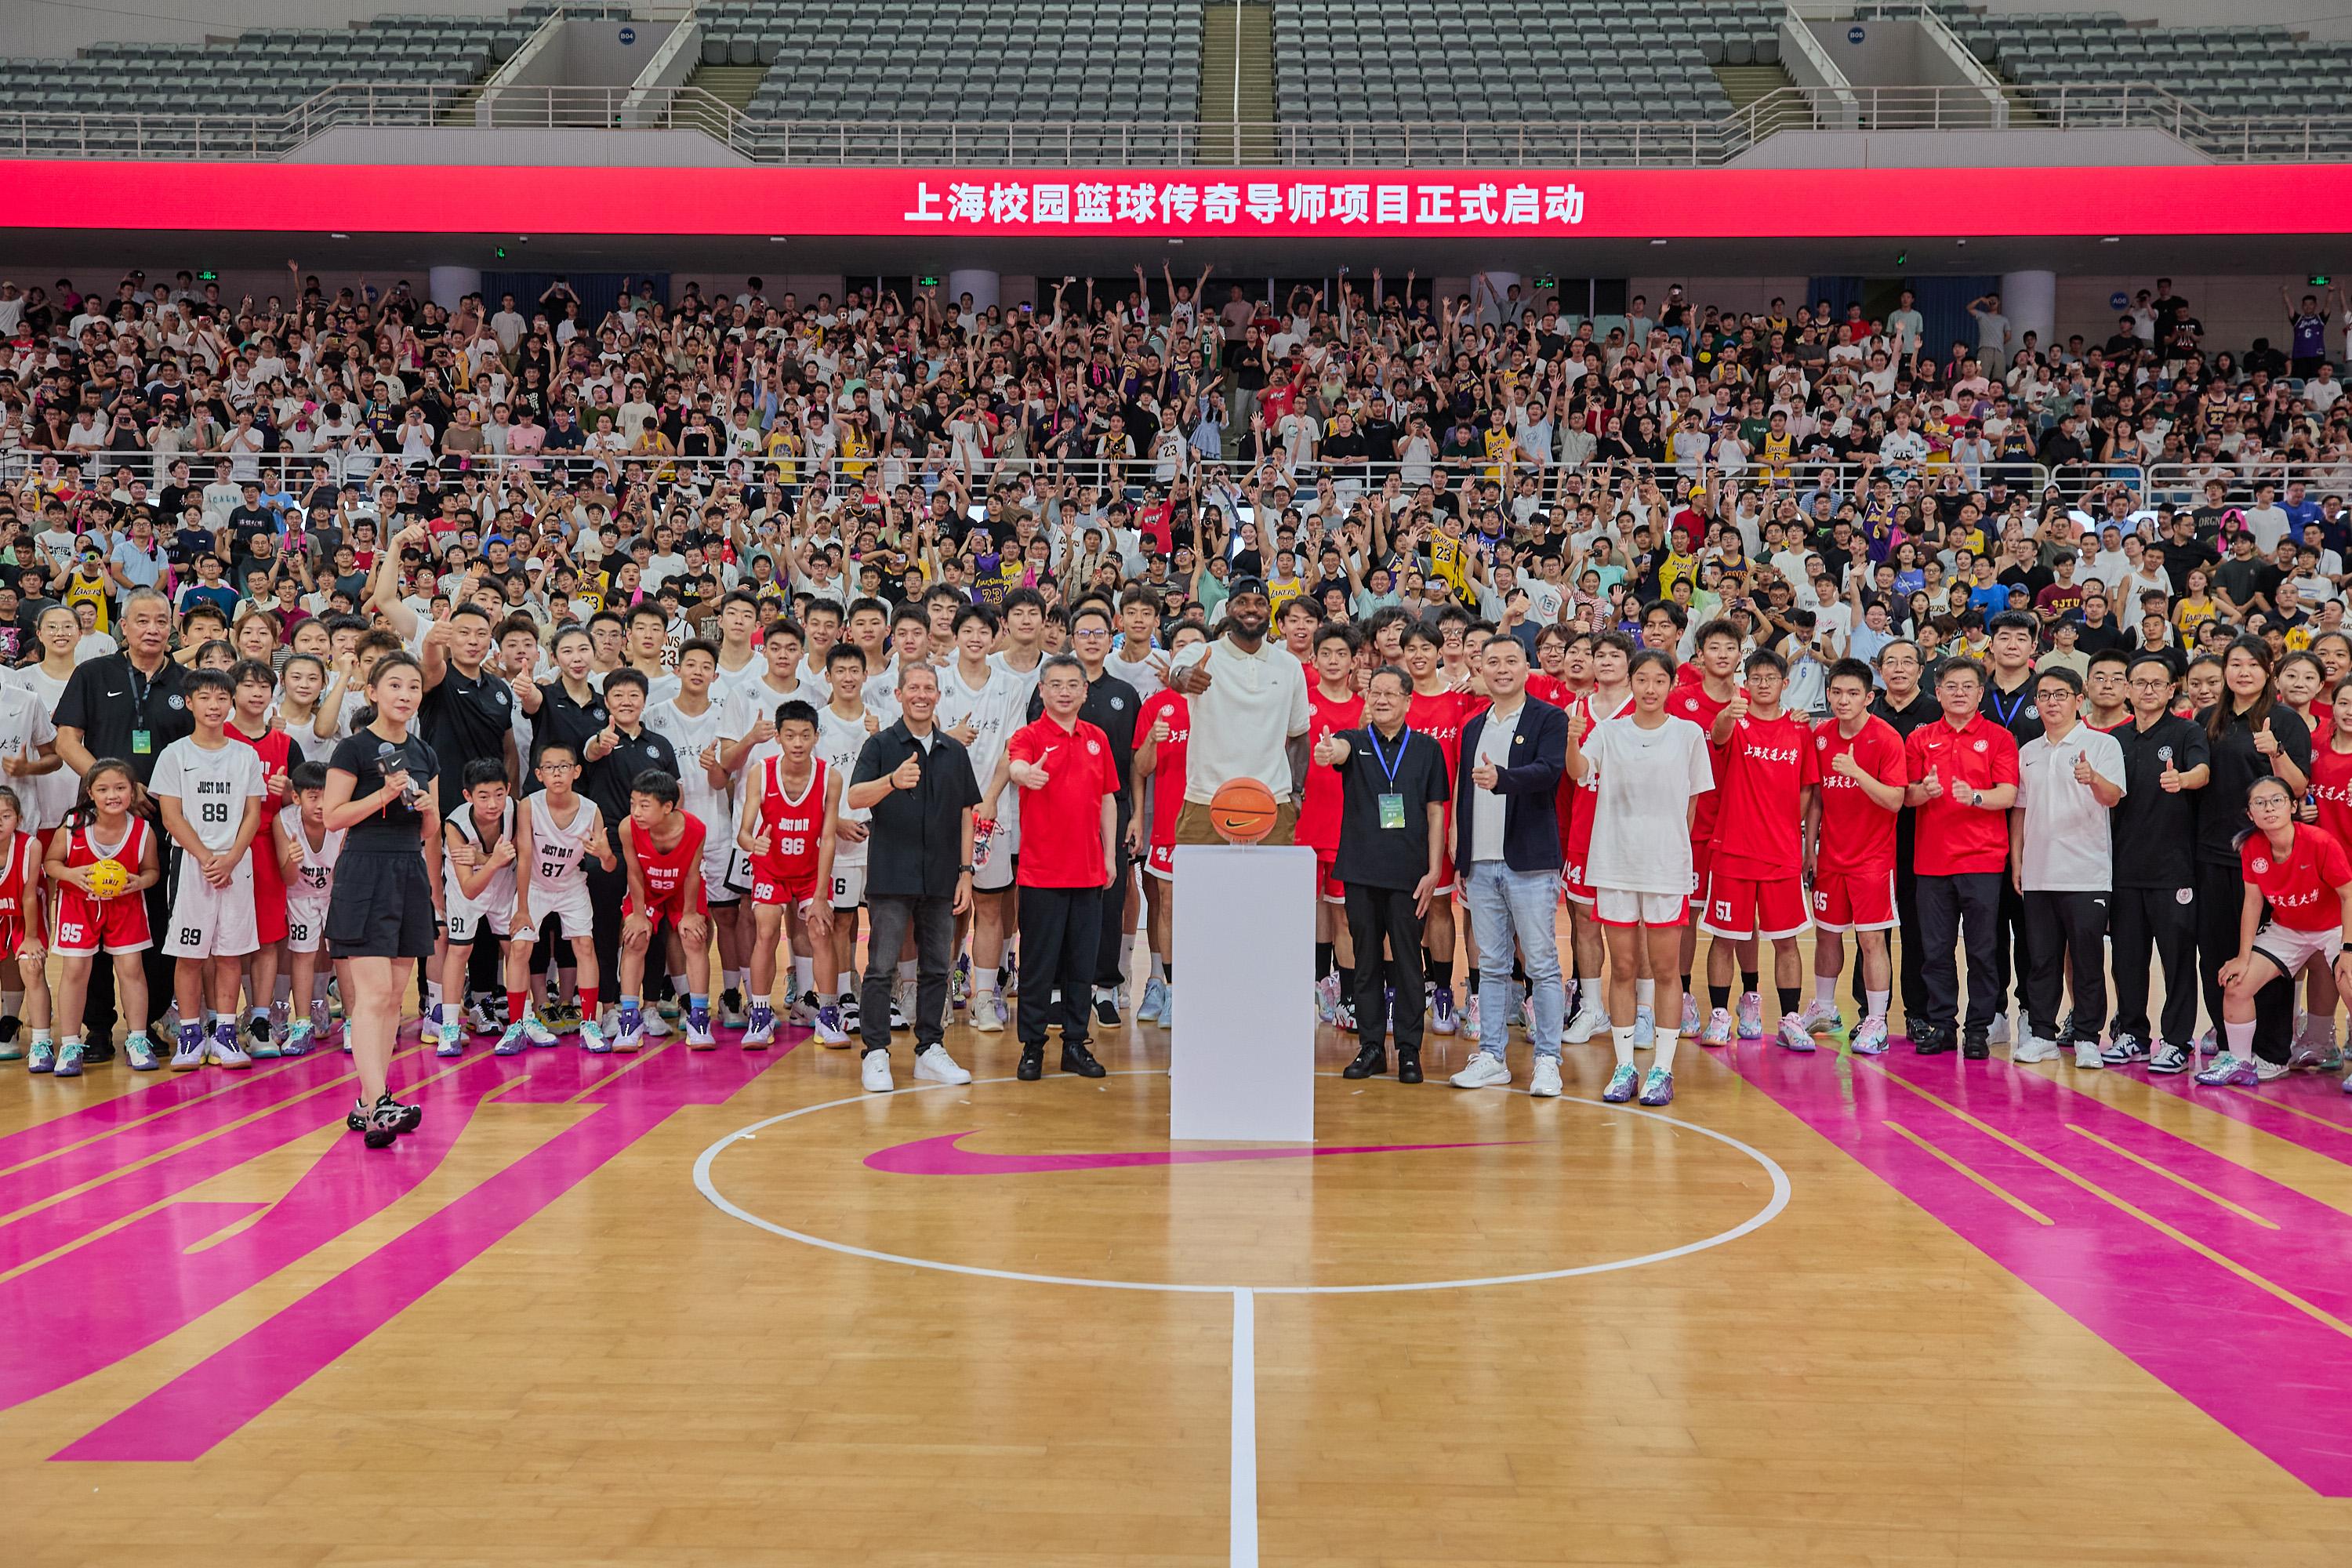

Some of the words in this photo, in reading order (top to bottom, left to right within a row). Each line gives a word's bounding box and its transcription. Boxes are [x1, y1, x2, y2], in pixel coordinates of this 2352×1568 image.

[904, 182, 1584, 225] 上海校园篮球传奇导师项目正式启动
[2305, 328, 2311, 338] 6
[1204, 343, 1211, 354] 0
[1163, 444, 1178, 458] 23
[1433, 534, 1455, 550] LAKERS
[1436, 546, 1452, 562] 23
[74, 586, 102, 596] LAKERS
[982, 588, 1004, 604] 23
[1271, 589, 1296, 599] LAKERS
[2052, 598, 2080, 608] SJTU
[2185, 614, 2212, 623] LAKERS
[1802, 666, 1807, 677] 6
[1169, 729, 1188, 743] 上海
[198, 782, 214, 794] JUST
[216, 782, 224, 794] DO
[225, 782, 230, 794] IT
[202, 803, 227, 822] 89
[779, 818, 794, 831] JUST
[794, 819, 802, 831] DO
[803, 818, 809, 831] IT
[542, 844, 556, 855] JUST
[558, 847, 566, 858] DO
[567, 848, 574, 858] IT
[781, 837, 805, 855] 96
[299, 866, 314, 878] JUST
[316, 867, 324, 877] DO
[542, 862, 566, 877] 87
[647, 866, 662, 877] JUST
[663, 869, 672, 877] DO
[672, 868, 679, 877] IT
[651, 879, 674, 889] 93
[753, 882, 774, 900] 96
[835, 878, 846, 895] 6
[1715, 900, 1732, 922] 51
[452, 916, 465, 933] 91
[60, 922, 83, 943] 95
[180, 927, 201, 946] 89
